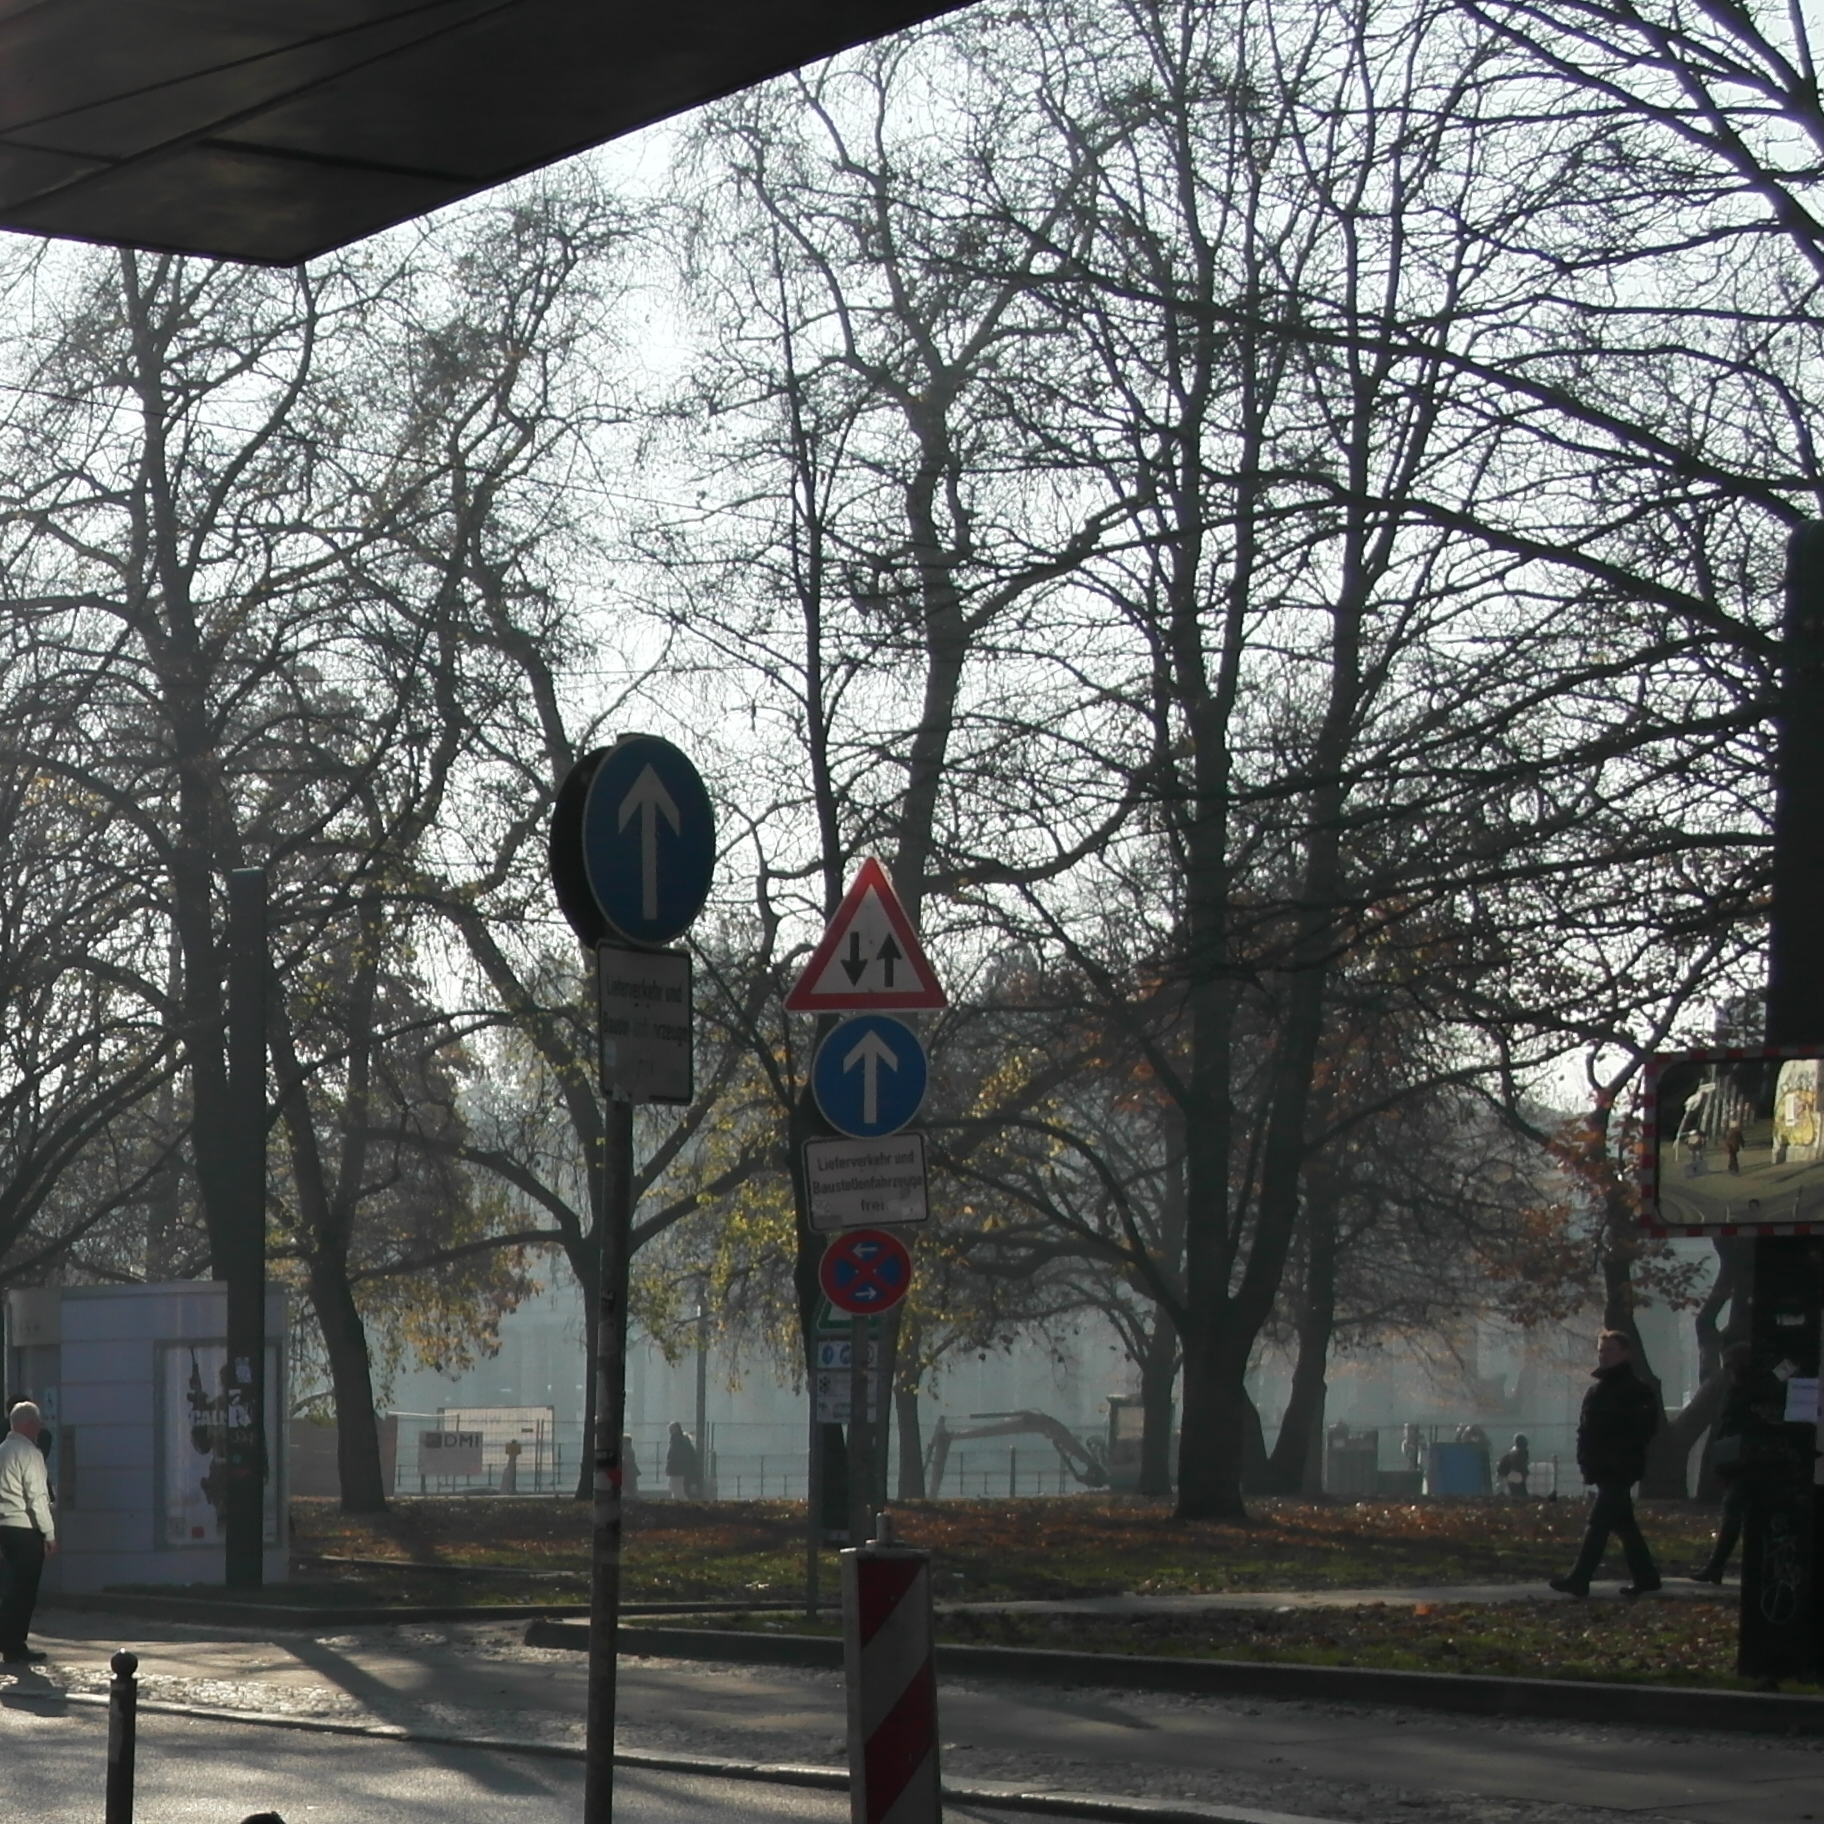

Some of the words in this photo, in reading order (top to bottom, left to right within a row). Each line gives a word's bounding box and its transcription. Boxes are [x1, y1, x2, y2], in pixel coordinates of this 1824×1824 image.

[817, 1152, 891, 1172] Lieferverkehr
[894, 1150, 915, 1164] und
[812, 1175, 922, 1195] Baustellenfahrzeuge
[860, 1199, 885, 1212] frei
[444, 1434, 479, 1449] DMI
